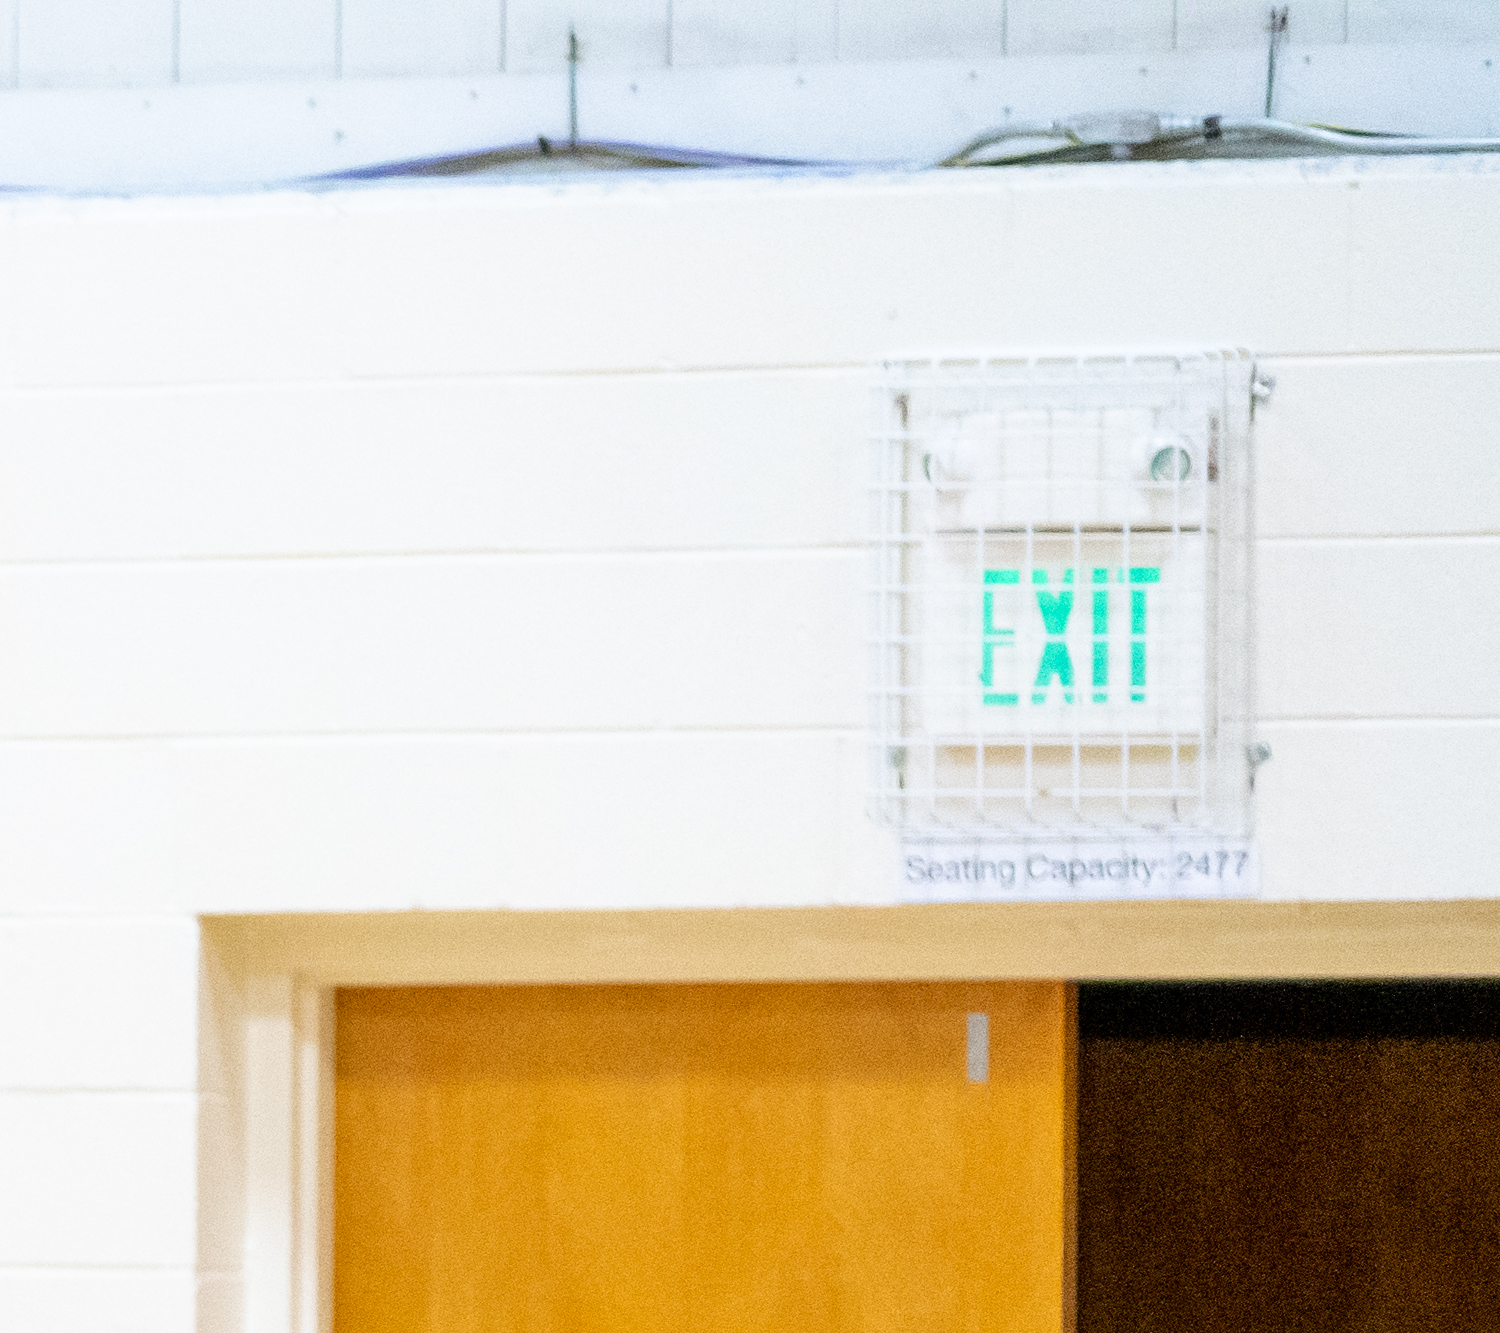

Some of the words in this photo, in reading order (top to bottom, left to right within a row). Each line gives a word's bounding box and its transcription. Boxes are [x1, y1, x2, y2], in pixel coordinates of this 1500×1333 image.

[982, 567, 1160, 706] EXIT
[906, 855, 1015, 887] Seating
[1178, 851, 1248, 877] 2477
